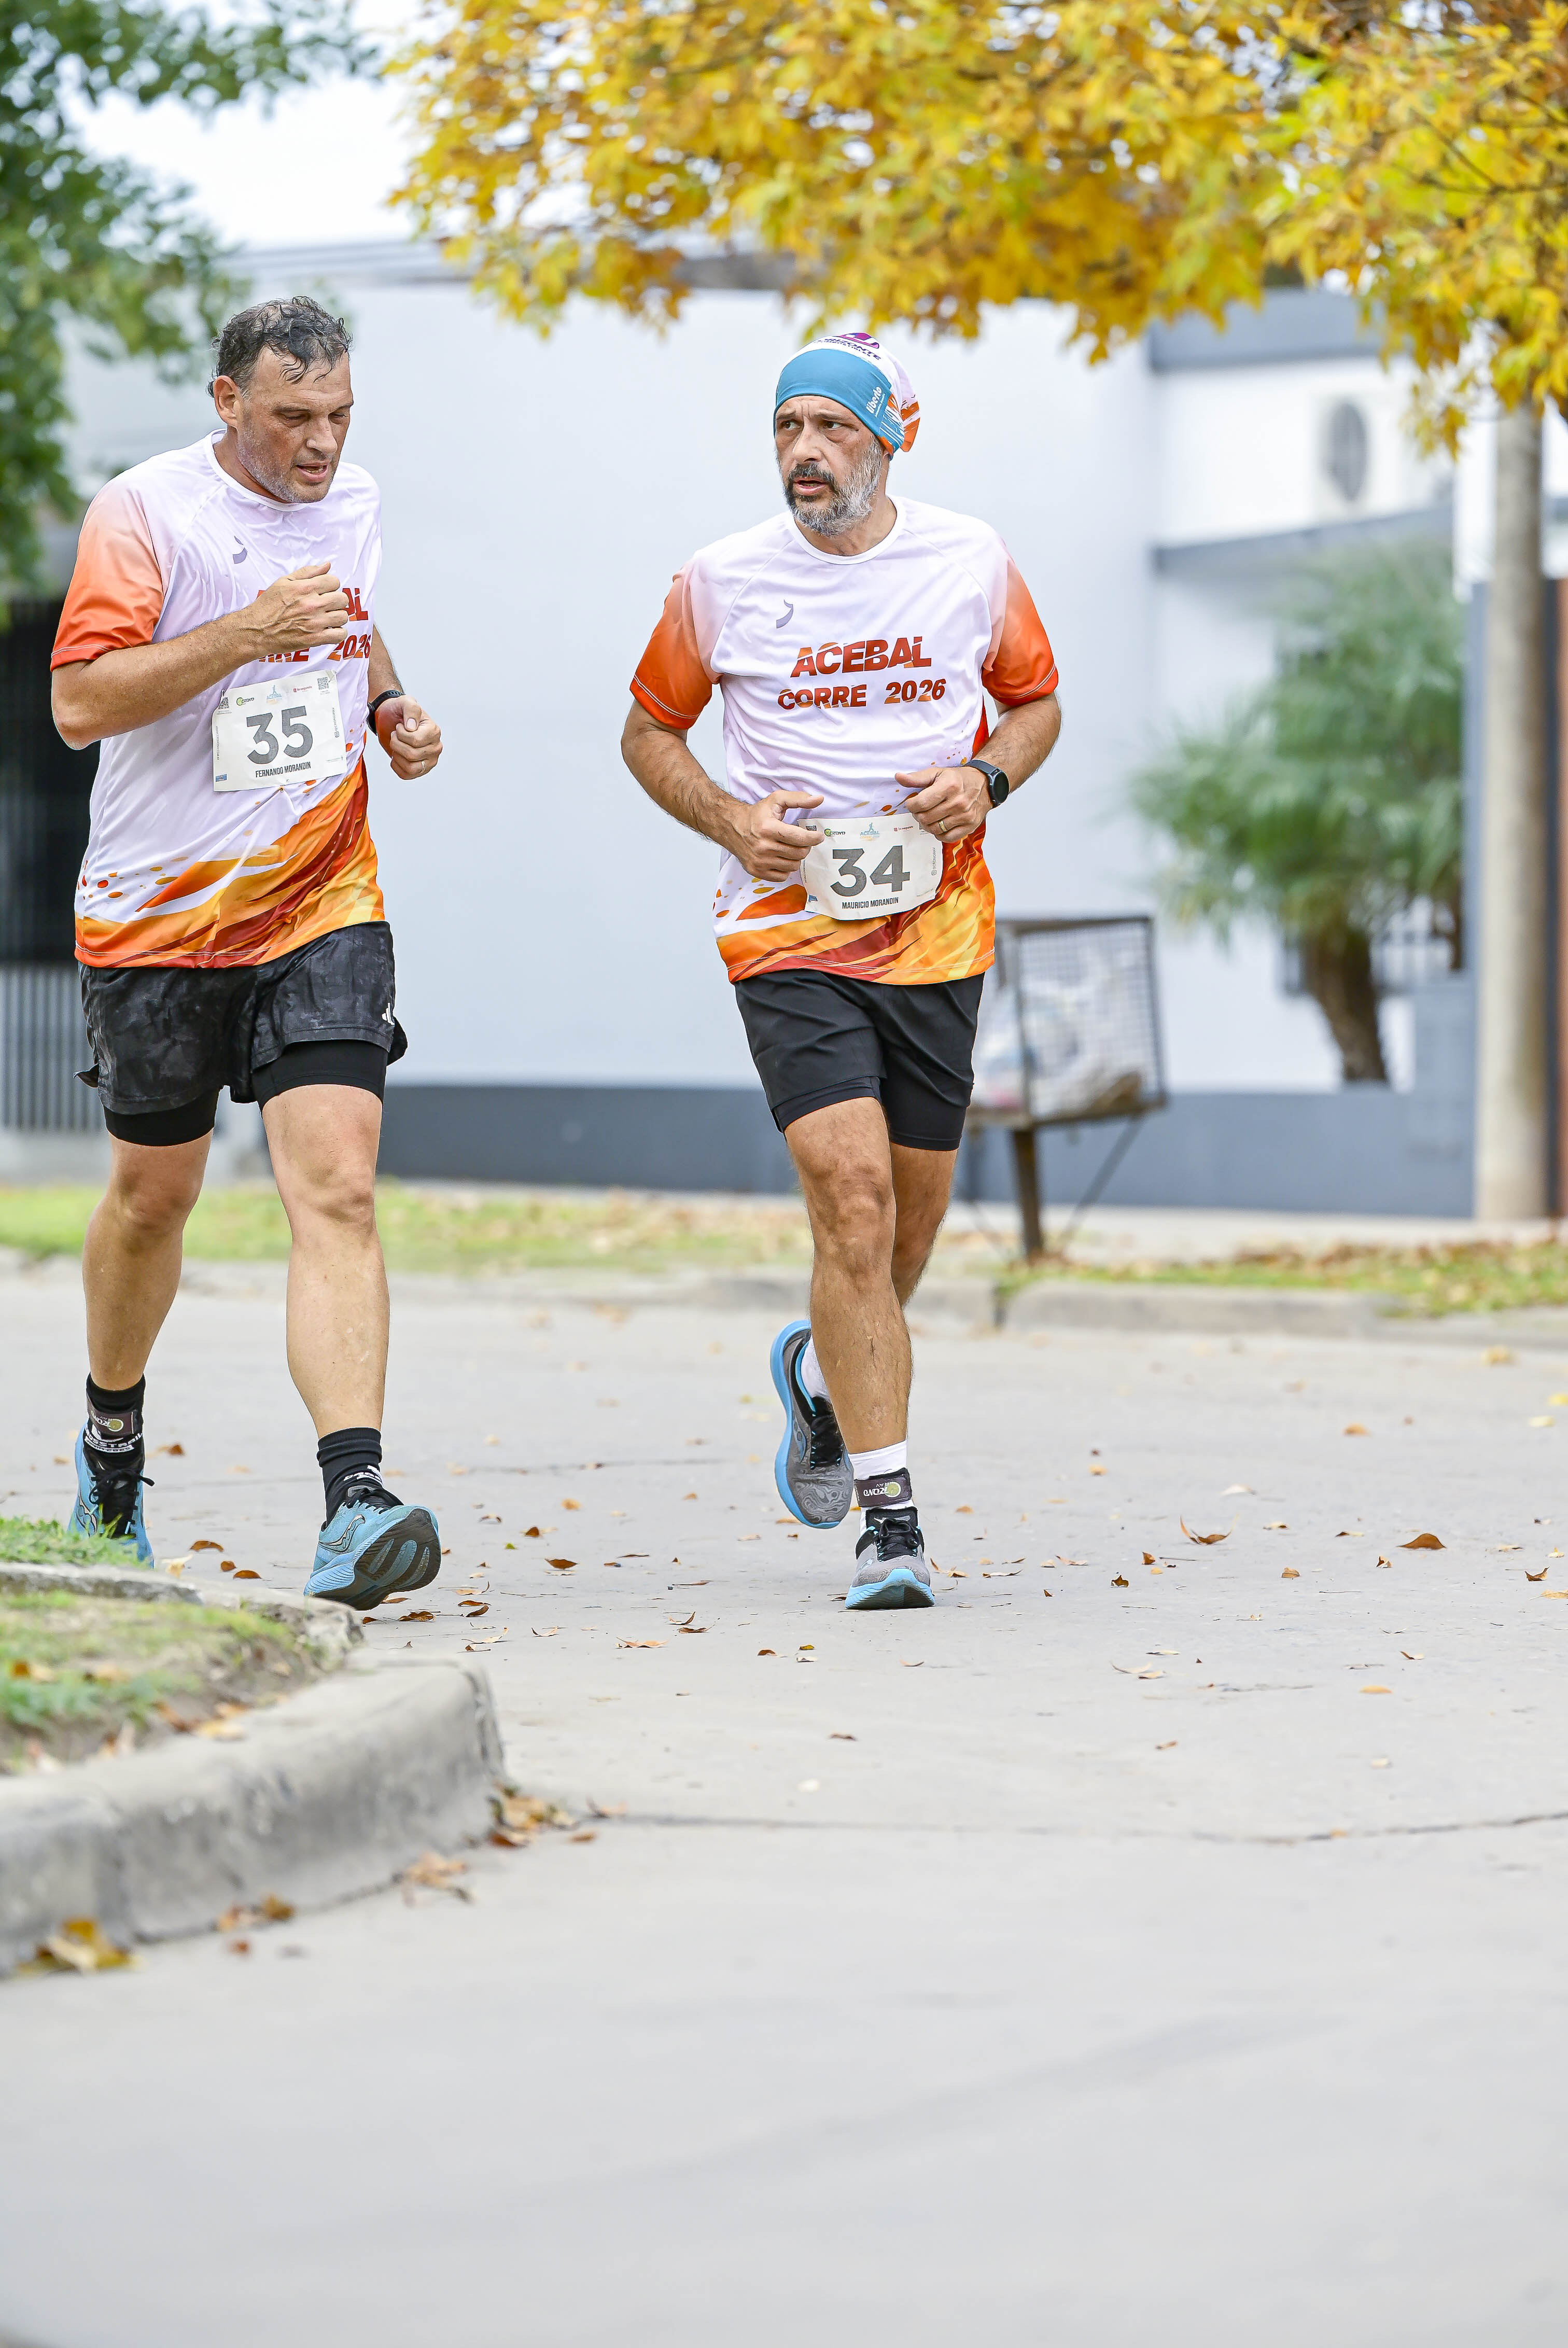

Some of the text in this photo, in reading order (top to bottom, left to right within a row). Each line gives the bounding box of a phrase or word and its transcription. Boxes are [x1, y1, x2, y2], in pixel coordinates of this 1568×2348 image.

[327, 634, 371, 661] 2026
[790, 636, 932, 678] ACEBAL
[777, 678, 947, 710] CORRE 2026
[246, 706, 313, 764] 35
[255, 761, 311, 778] FERNANDO MORANDIN
[830, 845, 911, 897] 34
[842, 897, 899, 909] MAURICIO MORANDIN
